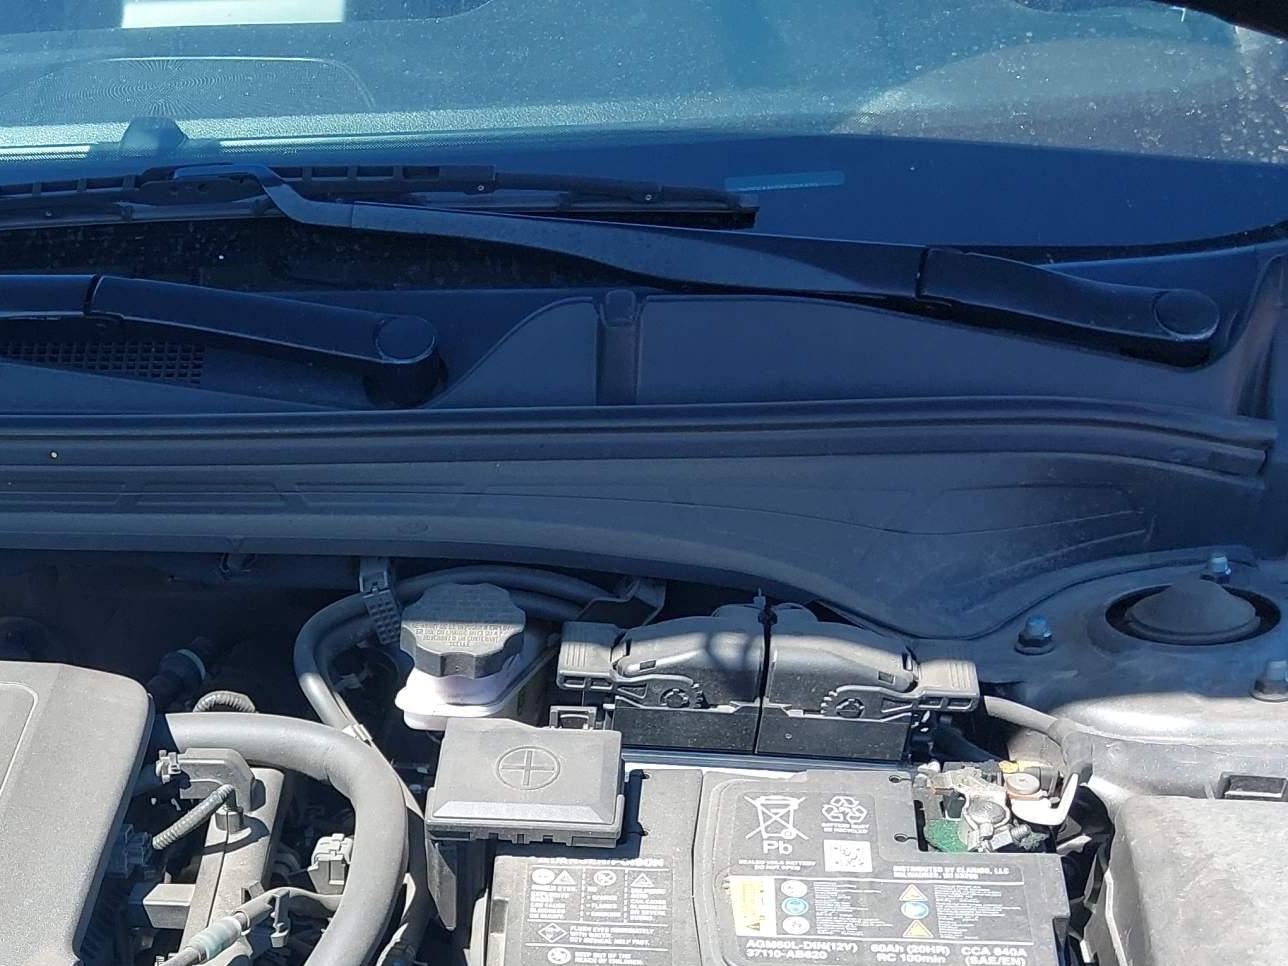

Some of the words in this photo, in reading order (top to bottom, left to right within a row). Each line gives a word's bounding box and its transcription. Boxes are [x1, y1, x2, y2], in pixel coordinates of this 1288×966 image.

[763, 840, 793, 855] Pb
[907, 944, 950, 956] (20HR)
[961, 946, 991, 956] CCA
[876, 953, 896, 962] RC
[899, 953, 947, 963] 100min
